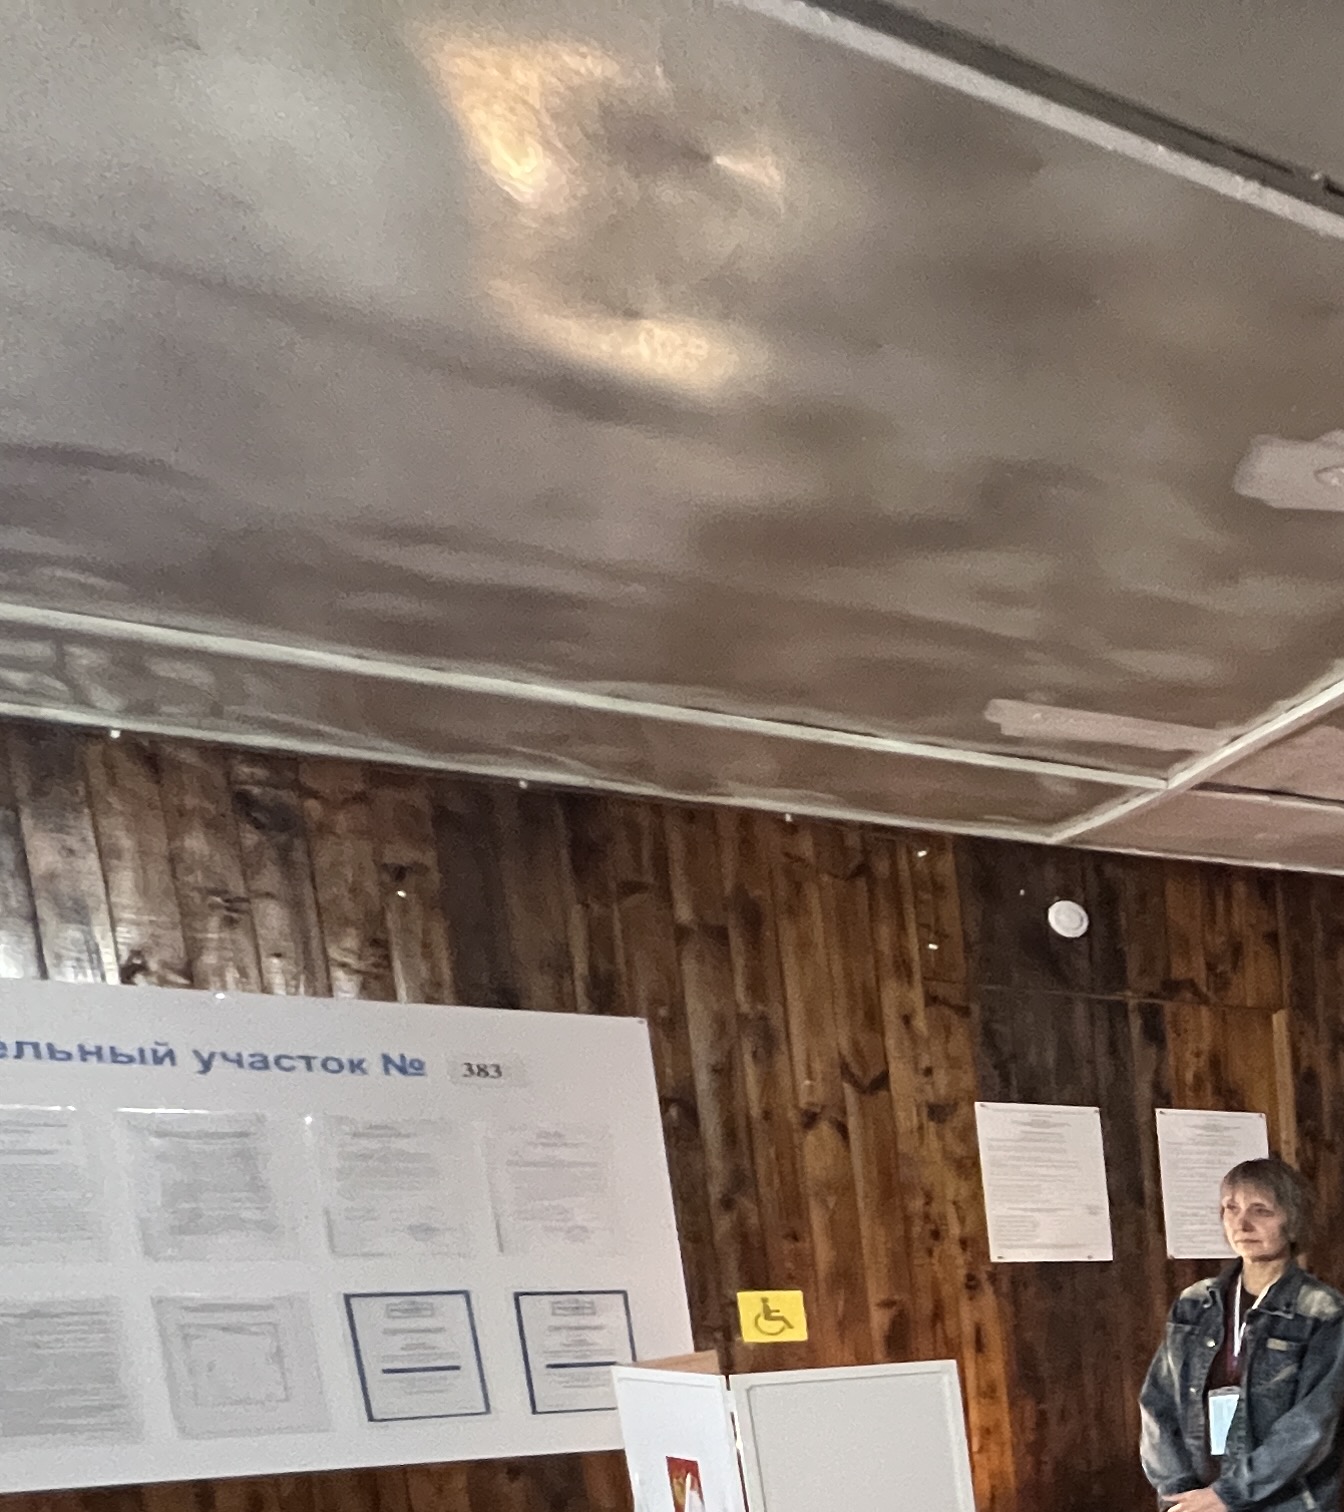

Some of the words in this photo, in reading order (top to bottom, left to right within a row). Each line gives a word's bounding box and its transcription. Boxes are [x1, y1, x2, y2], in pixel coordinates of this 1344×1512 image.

[0, 1040, 178, 1067] льный
[191, 1049, 368, 1076] участок
[381, 1053, 427, 1077] №
[461, 1061, 503, 1080] 383
